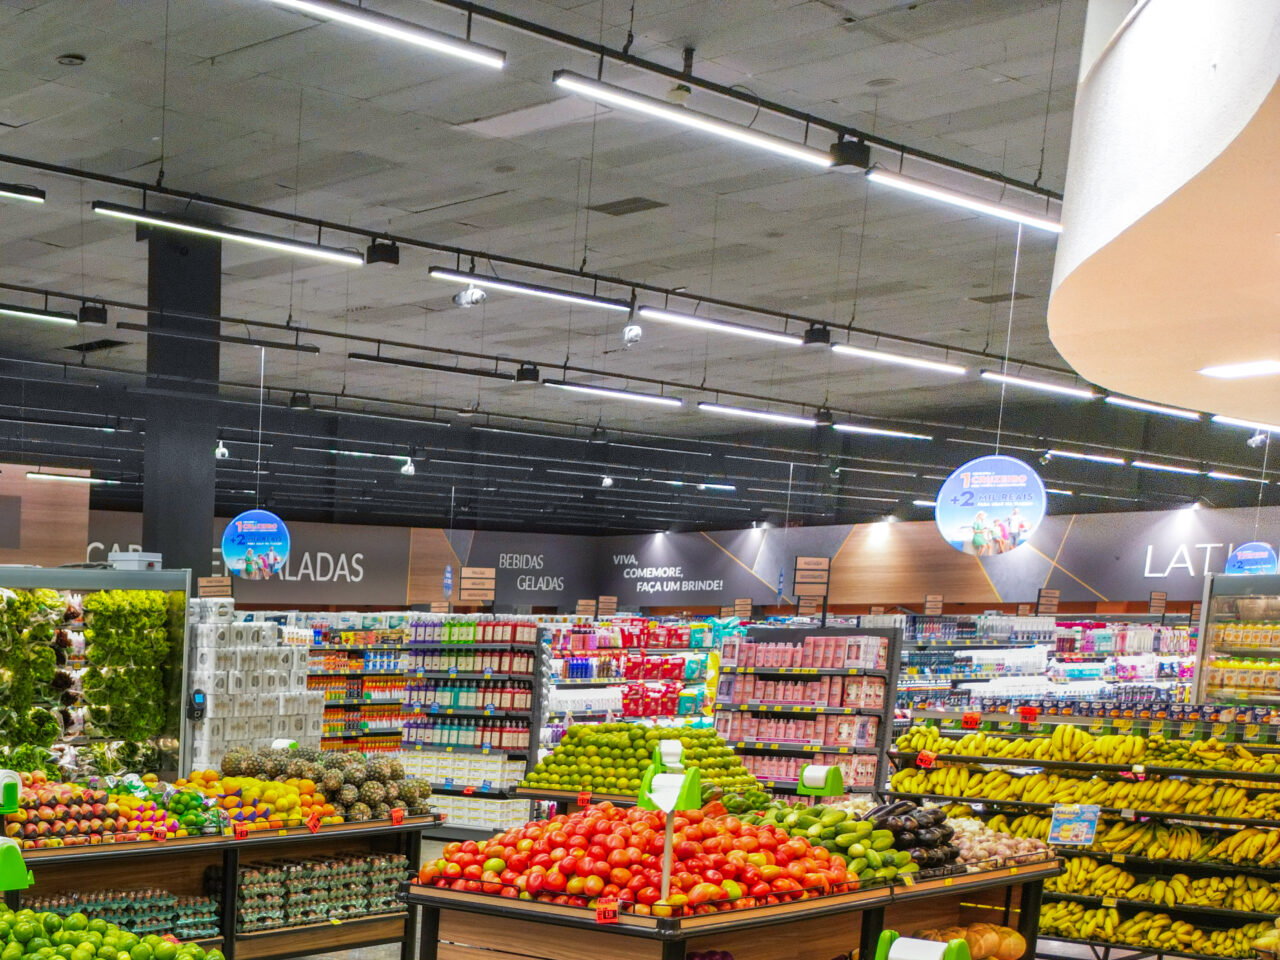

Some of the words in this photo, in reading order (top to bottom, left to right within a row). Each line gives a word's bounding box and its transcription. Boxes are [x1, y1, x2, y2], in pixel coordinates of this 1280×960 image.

[971, 474, 1027, 484] CRUZEIRO
[499, 553, 544, 570] BEBIDAS
[613, 554, 638, 567] VIVA,
[623, 566, 684, 580] COMEMORE,
[517, 574, 565, 592] GELADAS
[636, 580, 662, 595] FAÇA
[663, 581, 680, 592] UM
[681, 579, 724, 593] BRINDE!
